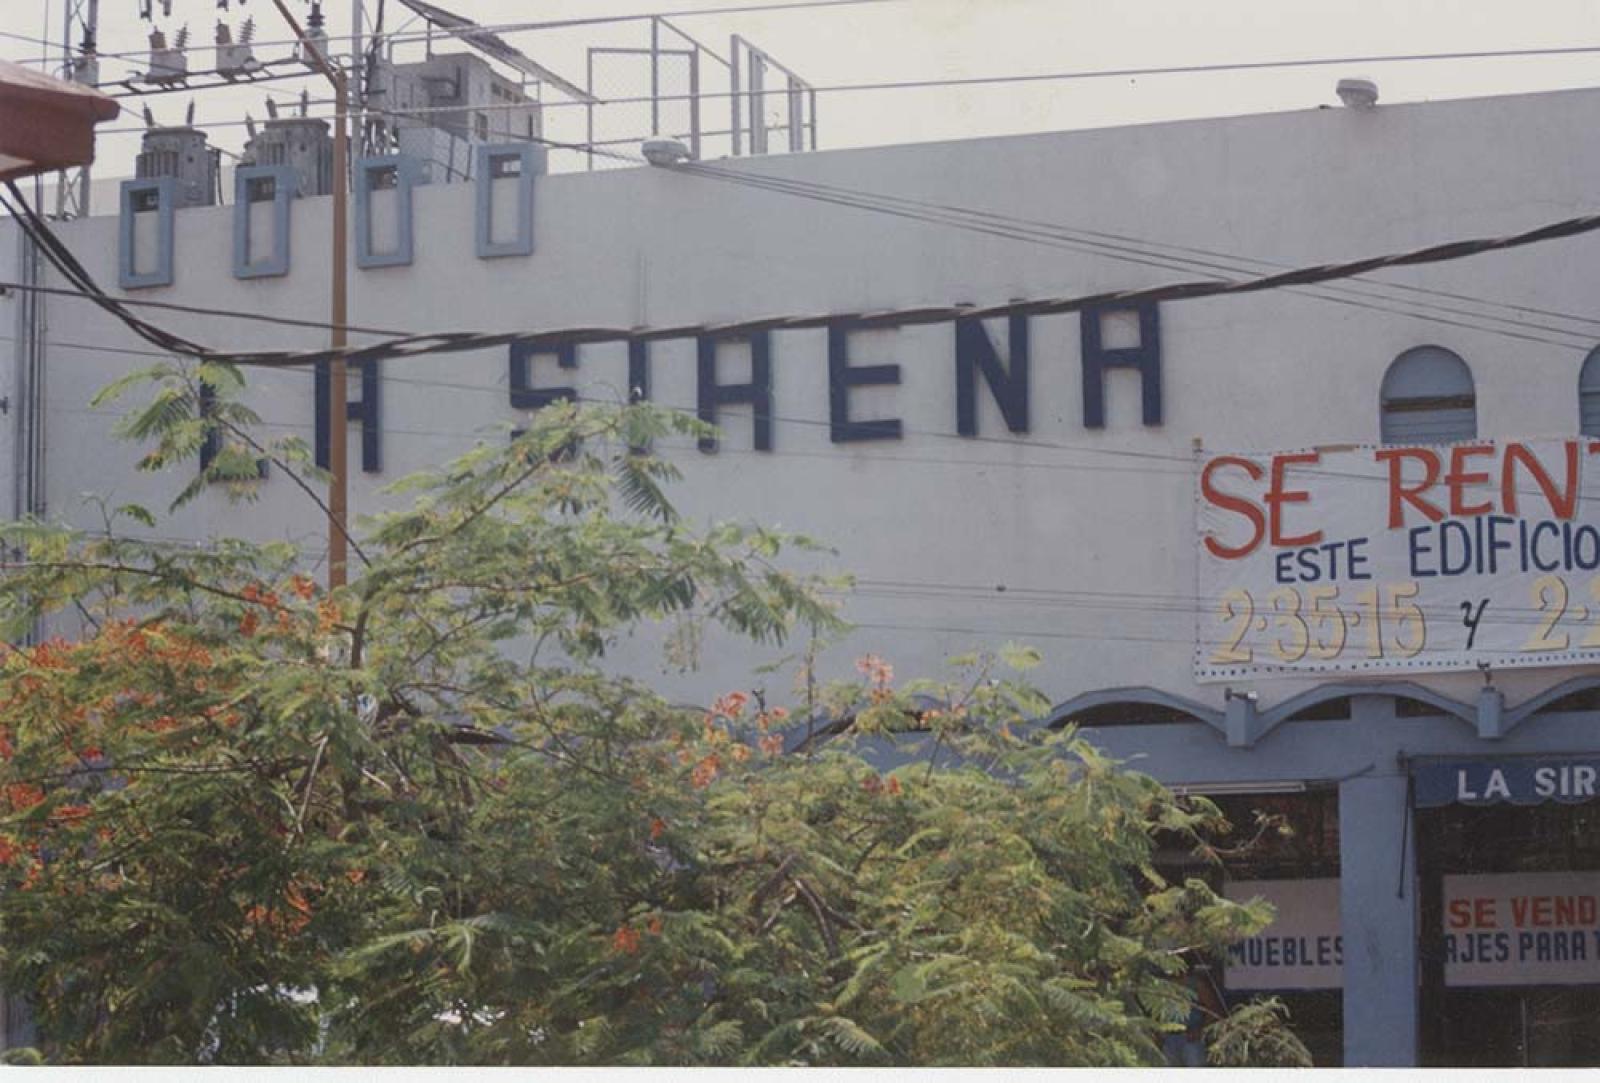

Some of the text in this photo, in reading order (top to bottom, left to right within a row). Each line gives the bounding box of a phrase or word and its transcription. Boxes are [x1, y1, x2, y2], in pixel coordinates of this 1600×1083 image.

[1202, 452, 1324, 560] SE
[1275, 516, 1600, 583] ESTE EDIFICIO
[1457, 765, 1597, 799] LA SIR
[1449, 895, 1597, 929] SE VEND
[1518, 930, 1586, 962] PARA
